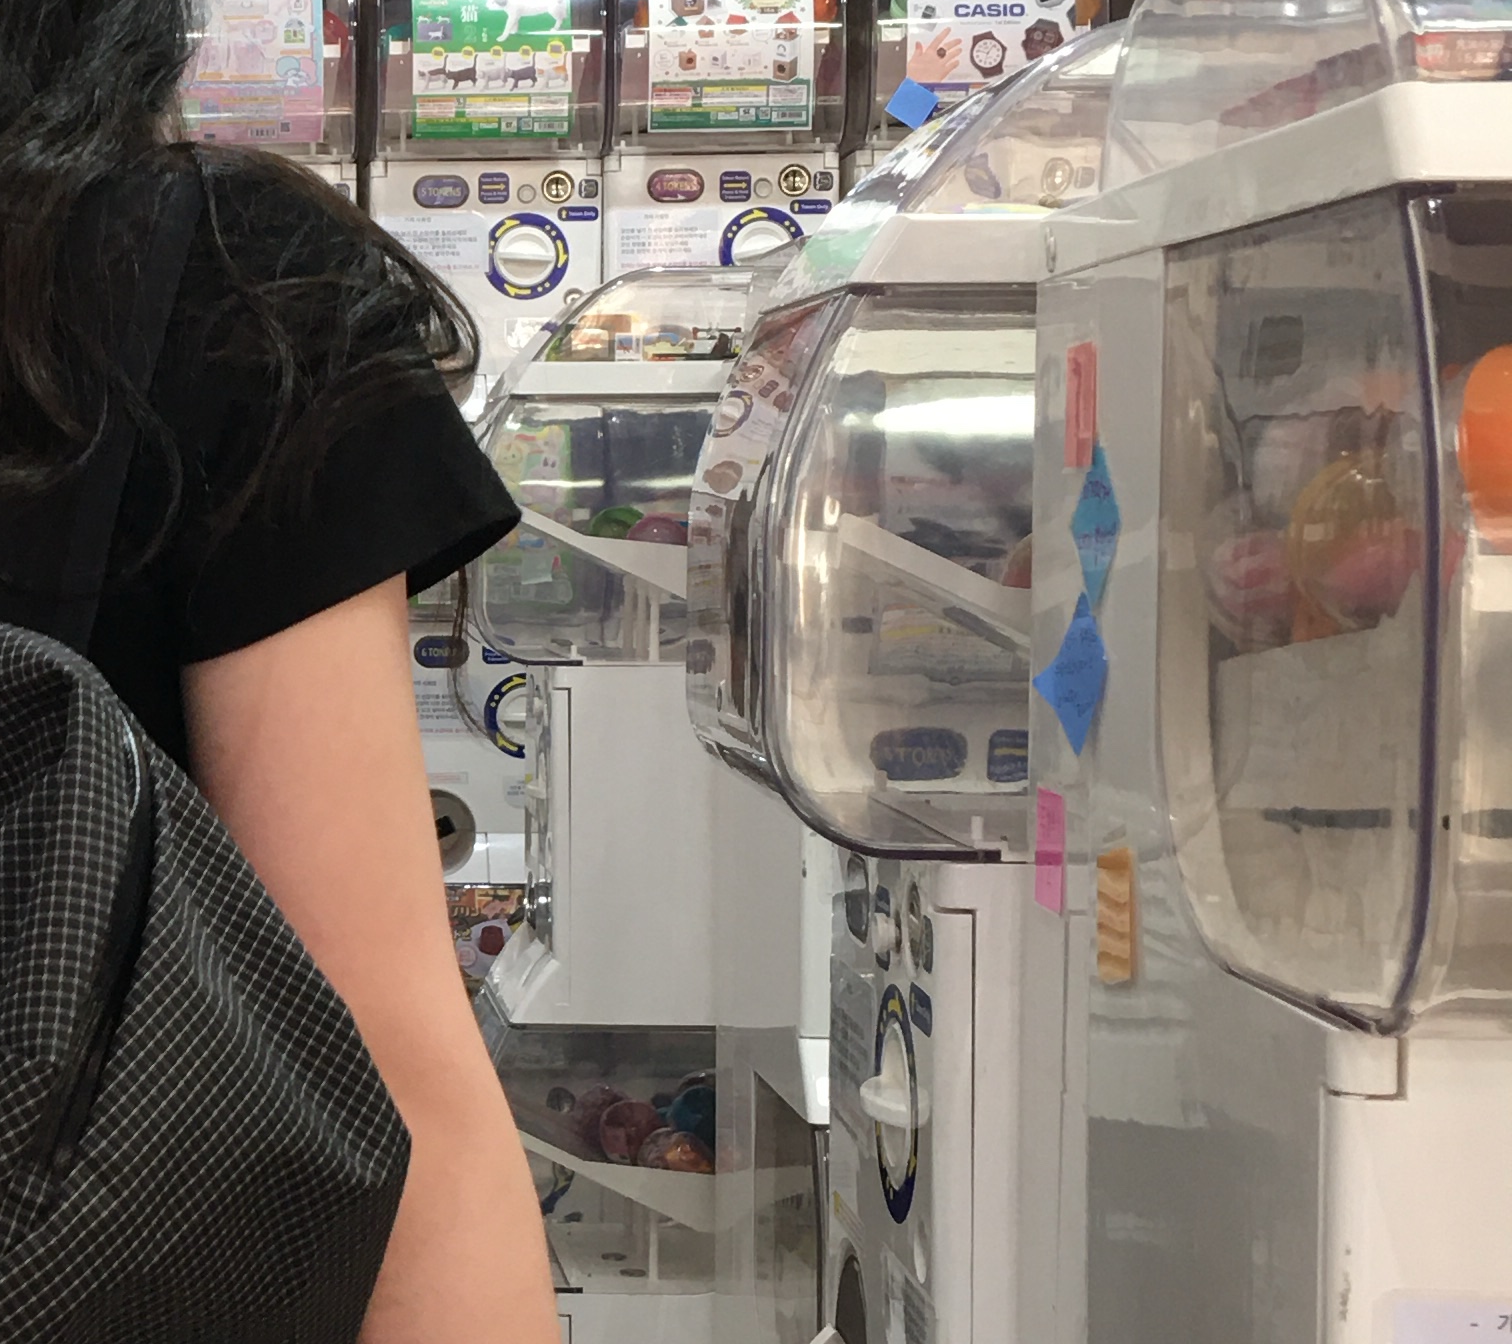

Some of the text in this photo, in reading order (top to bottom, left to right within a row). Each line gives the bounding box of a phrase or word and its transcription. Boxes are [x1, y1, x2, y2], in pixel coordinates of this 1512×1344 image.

[954, 3, 1026, 18] CASIO
[428, 186, 462, 197] TOKENS
[663, 181, 700, 192] TOKENS
